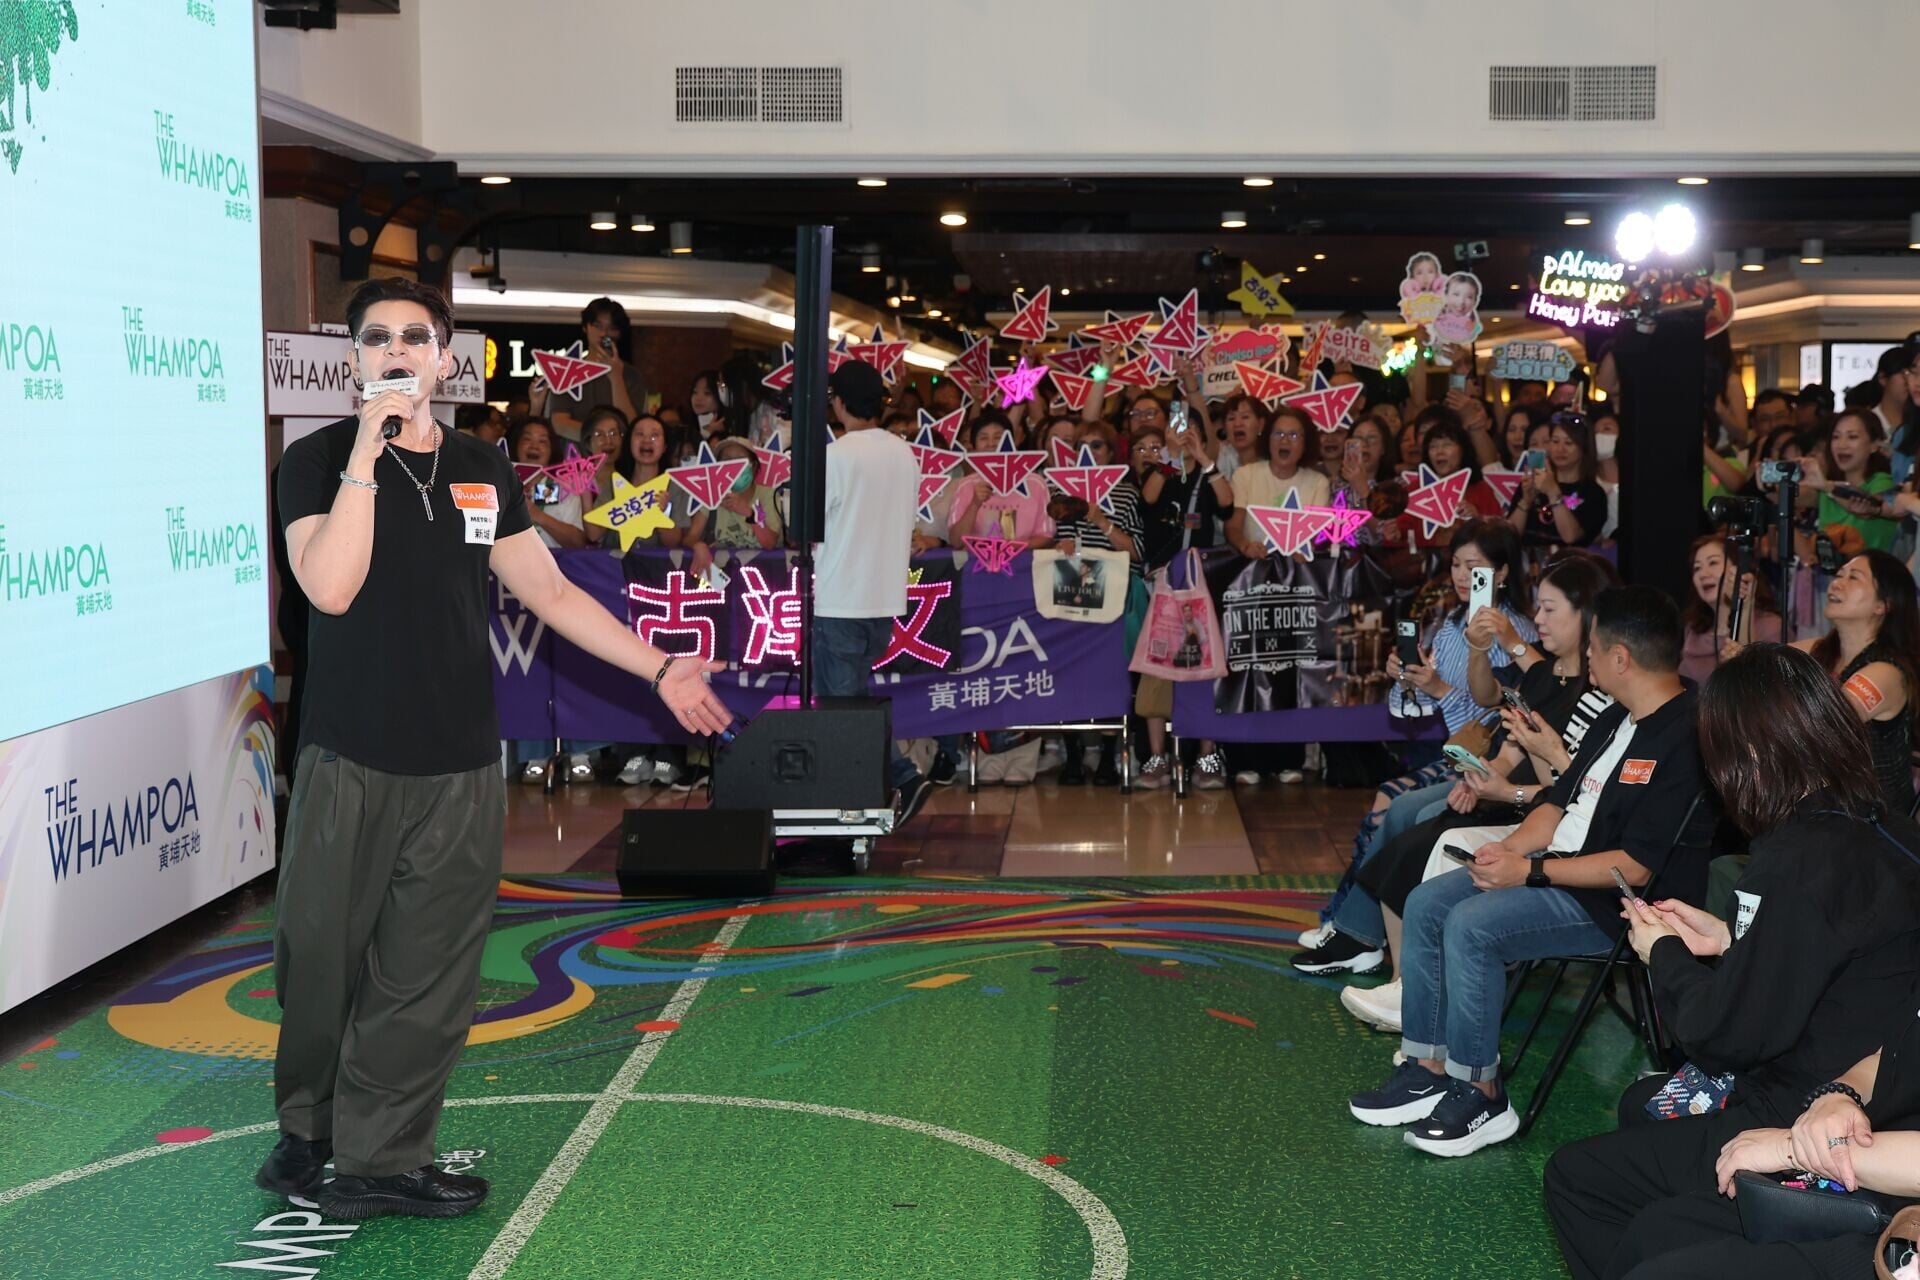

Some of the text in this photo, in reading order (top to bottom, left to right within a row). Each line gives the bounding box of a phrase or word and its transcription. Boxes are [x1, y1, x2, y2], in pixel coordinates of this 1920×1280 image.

[154, 110, 174, 138] THE
[156, 136, 250, 199] WHAMPOA
[122, 306, 144, 332] THE
[124, 332, 224, 379] WHAMPOA
[268, 338, 291, 357] THE
[24, 378, 64, 401] 黃埔天地
[166, 506, 186, 531] THE
[168, 523, 260, 574] WHAMPOA
[76, 591, 113, 617] 黃埔天地
[1223, 606, 1318, 633] ON THE ROCKS
[928, 669, 1056, 712] 黃埔天地
[45, 778, 78, 823] THE
[47, 770, 199, 885] WHAMPOA
[159, 829, 201, 872] 黃埔天地
[1467, 1110, 1490, 1133] HOKA
